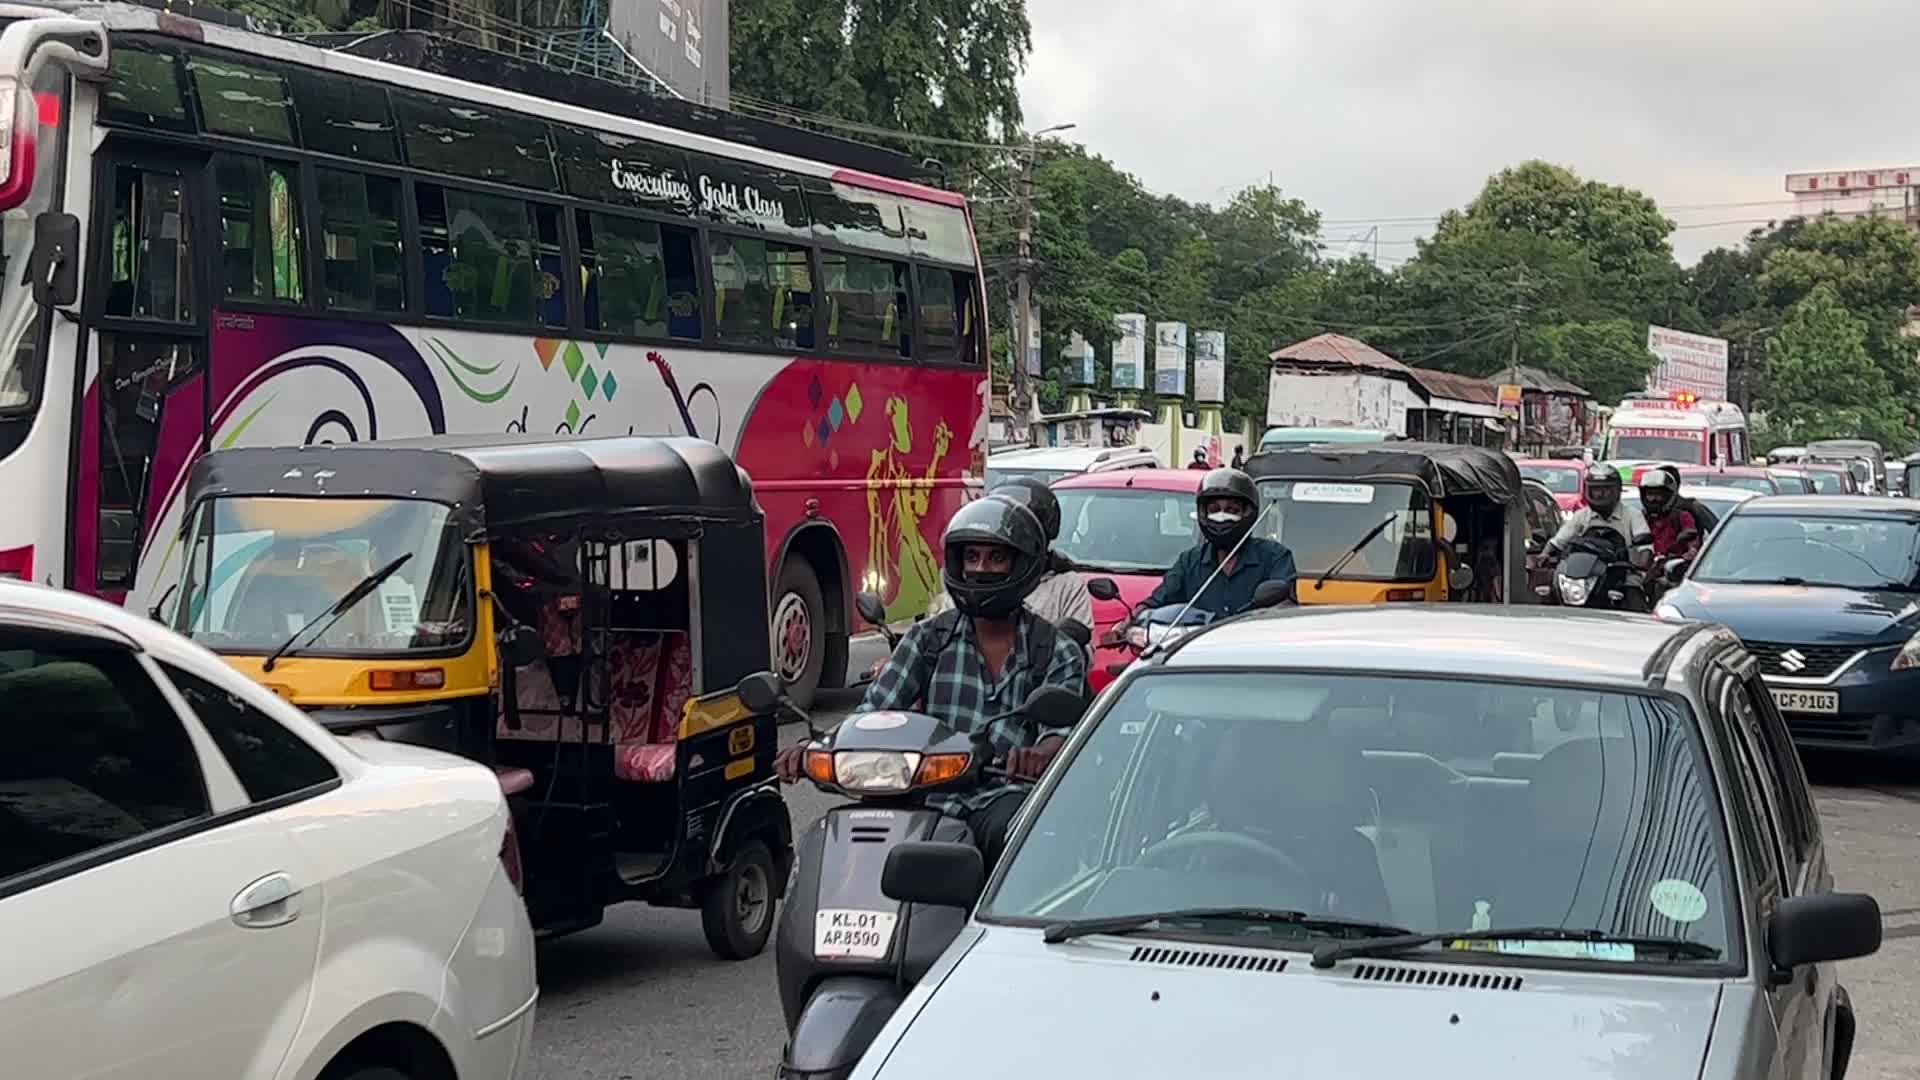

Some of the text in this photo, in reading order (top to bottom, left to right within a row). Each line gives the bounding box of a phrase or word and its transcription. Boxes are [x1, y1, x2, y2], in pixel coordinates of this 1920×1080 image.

[611, 158, 784, 218] Executive Gold Class
[832, 913, 878, 929] KL.01
